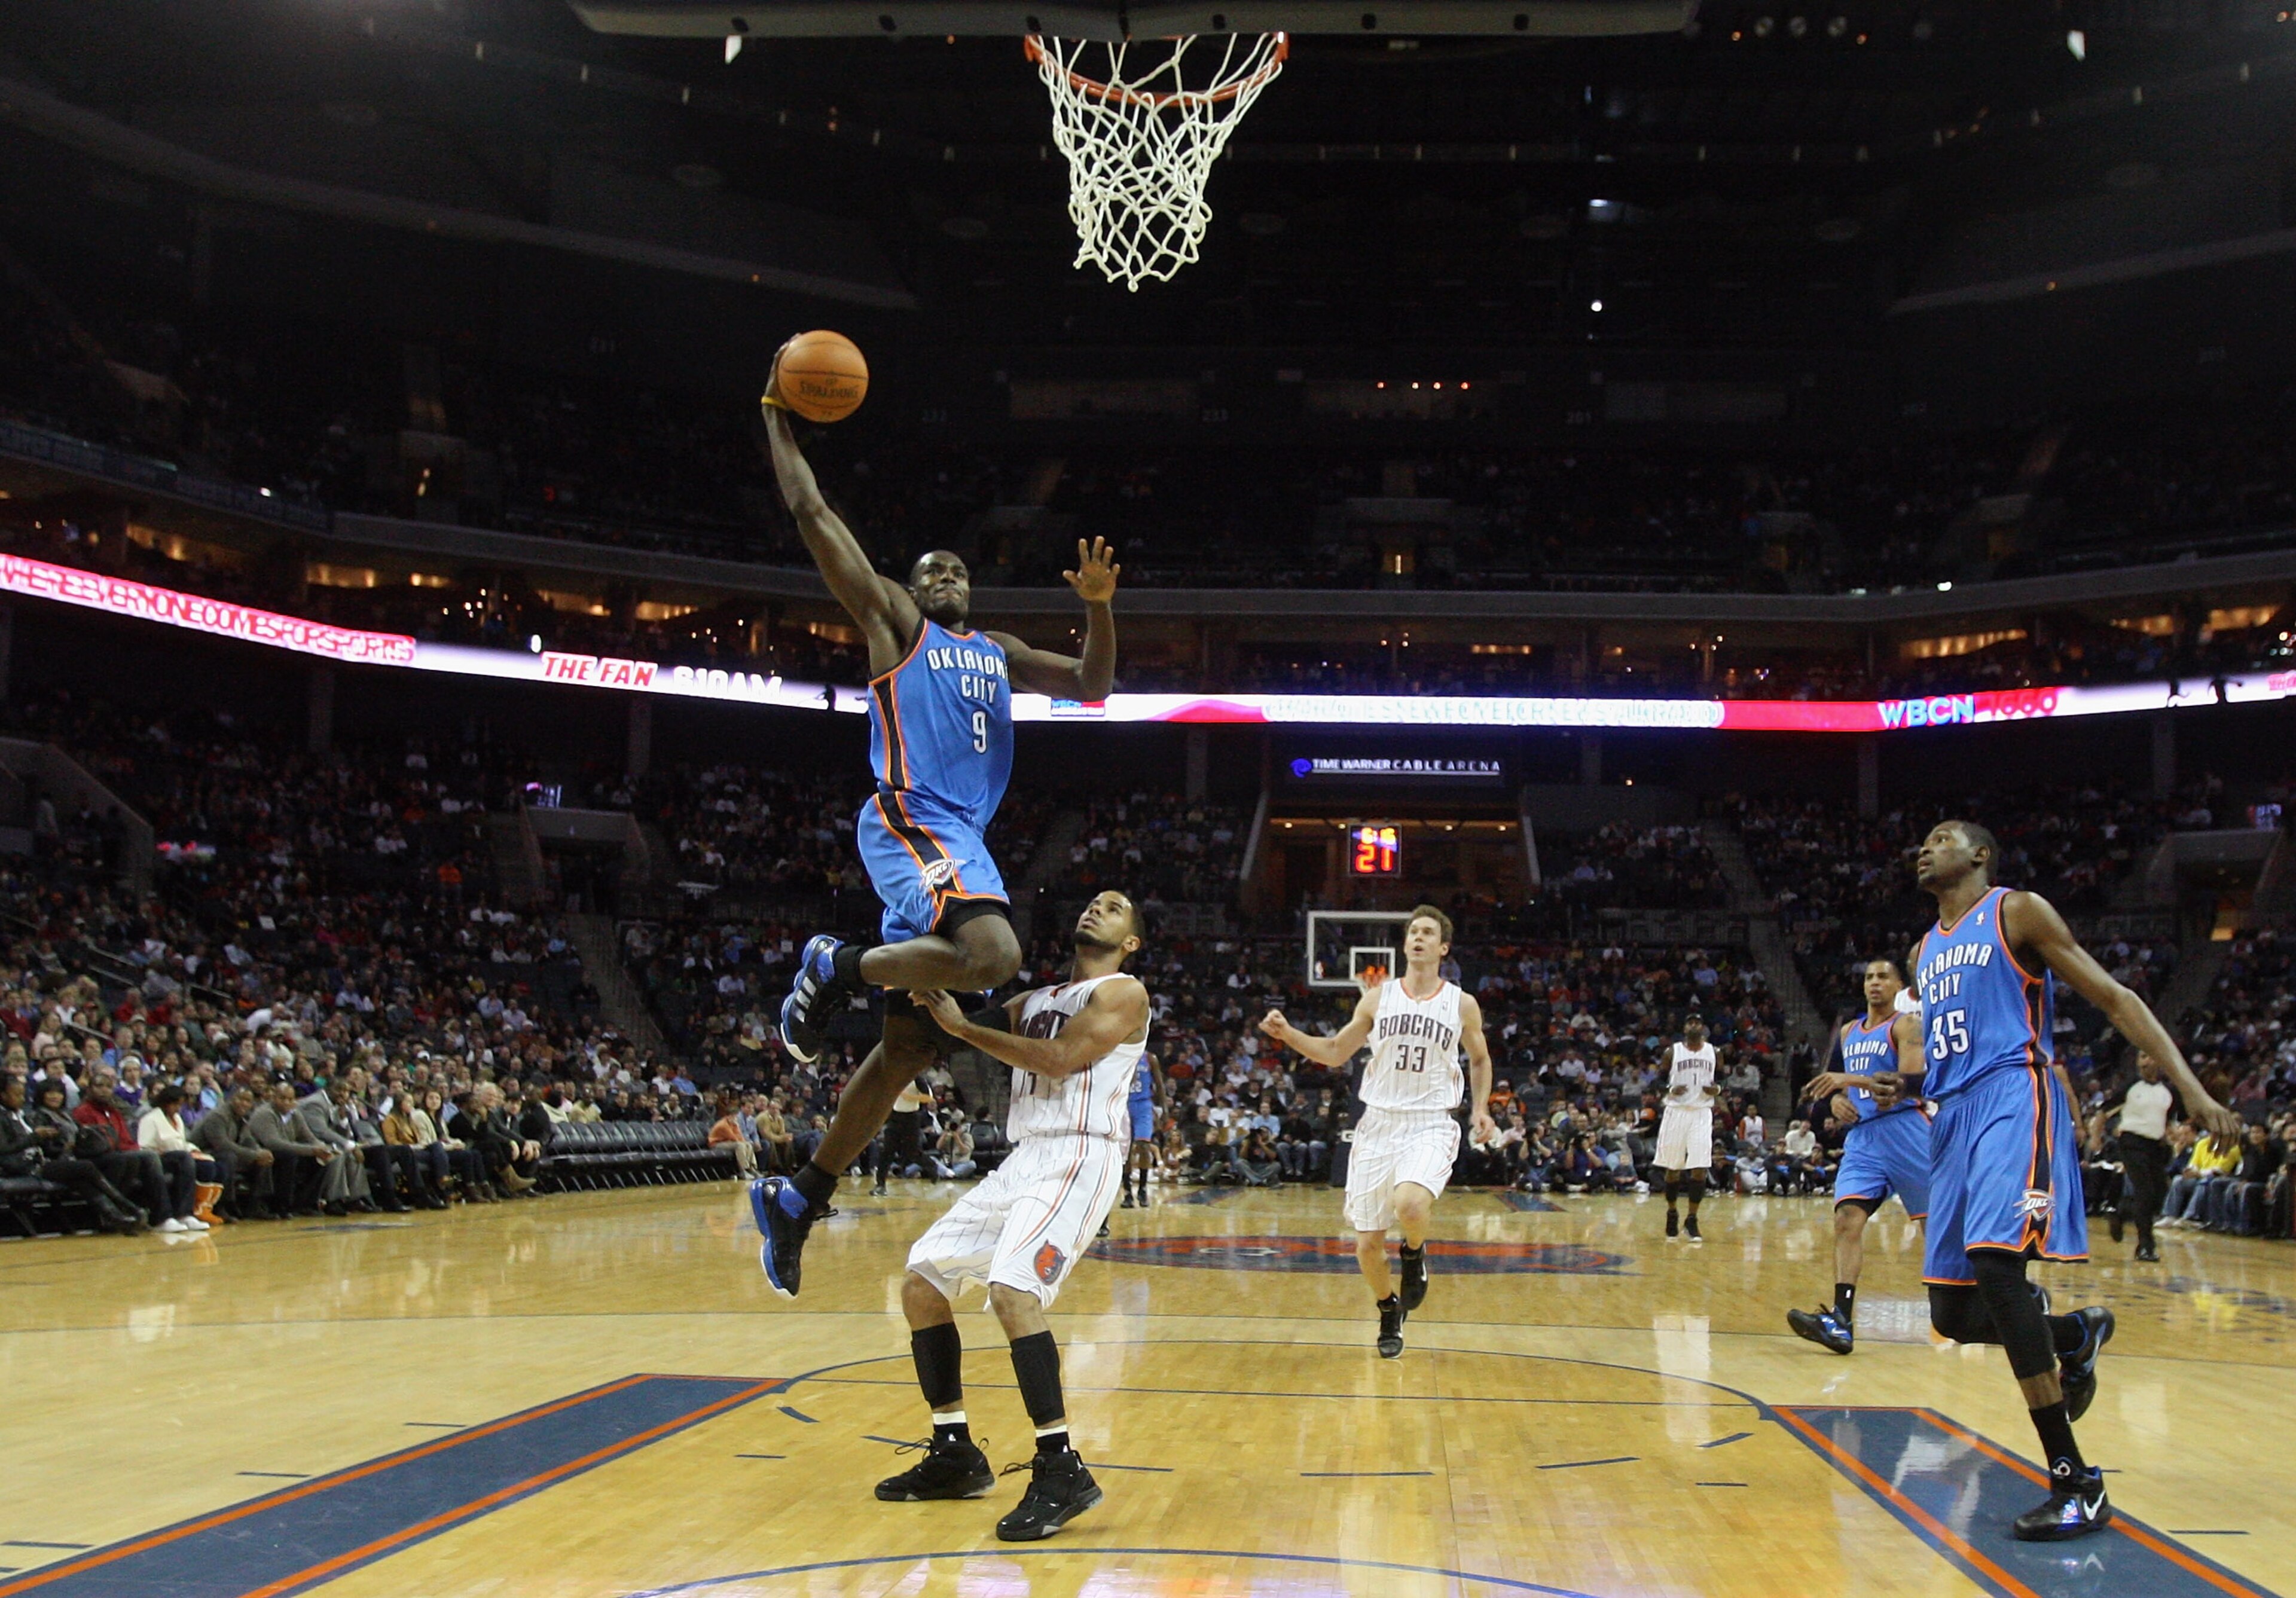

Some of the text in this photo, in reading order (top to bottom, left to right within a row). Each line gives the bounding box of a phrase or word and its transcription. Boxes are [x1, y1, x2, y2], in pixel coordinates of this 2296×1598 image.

[545, 657, 594, 680] THE
[600, 663, 654, 687] FAN
[961, 674, 997, 704] CITY
[1877, 695, 1974, 728] WBCN
[972, 711, 987, 754] 9
[1312, 759, 1500, 771] TIME WARNER CABLE ARENA
[1355, 844, 1393, 873] 21
[1929, 973, 1961, 1005] CITY
[1379, 1014, 1453, 1052] BOBCATS
[1932, 1009, 1969, 1060] 35
[1396, 1044, 1427, 1073] 33
[1850, 1056, 1870, 1072] CITY
